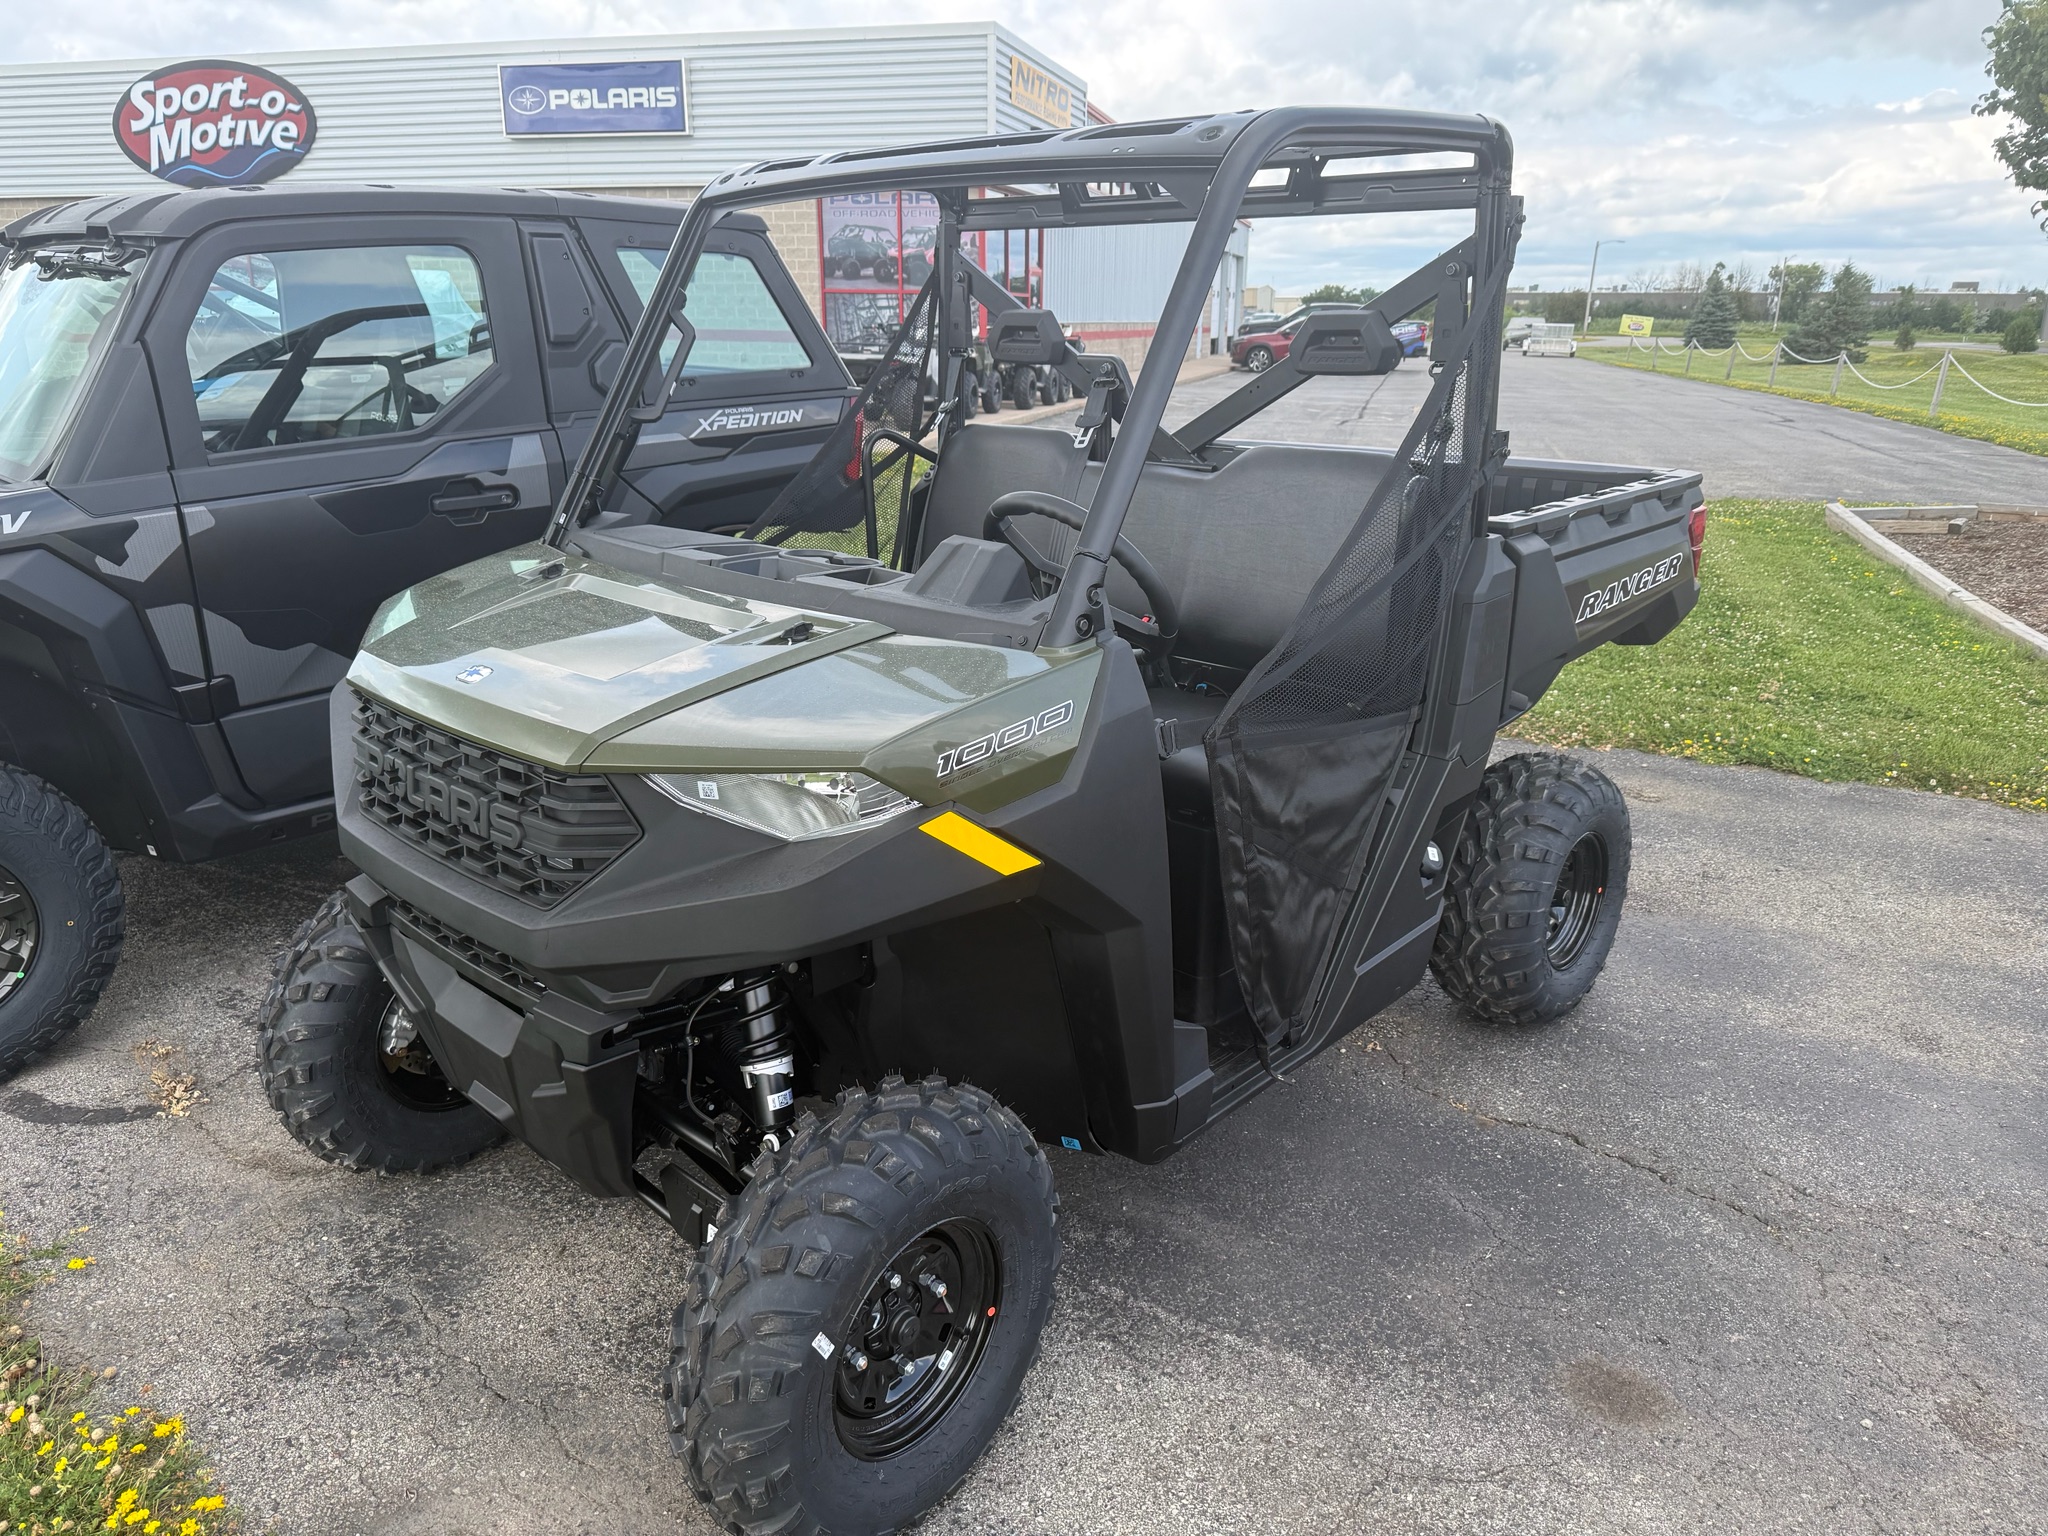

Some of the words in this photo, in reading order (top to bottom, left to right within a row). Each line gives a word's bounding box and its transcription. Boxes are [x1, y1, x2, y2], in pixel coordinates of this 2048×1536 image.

[549, 87, 677, 110] POLARIS
[1015, 61, 1069, 112] NITRO
[150, 113, 298, 173] Motive
[833, 209, 897, 218] OFF-ROAD
[689, 408, 804, 438] XPEDITION
[724, 406, 754, 415] POLARIS
[1575, 552, 1683, 624] RANGER
[937, 699, 1074, 778] 1000
[365, 741, 523, 849] POLARIS
[939, 765, 984, 789] SINGLE
